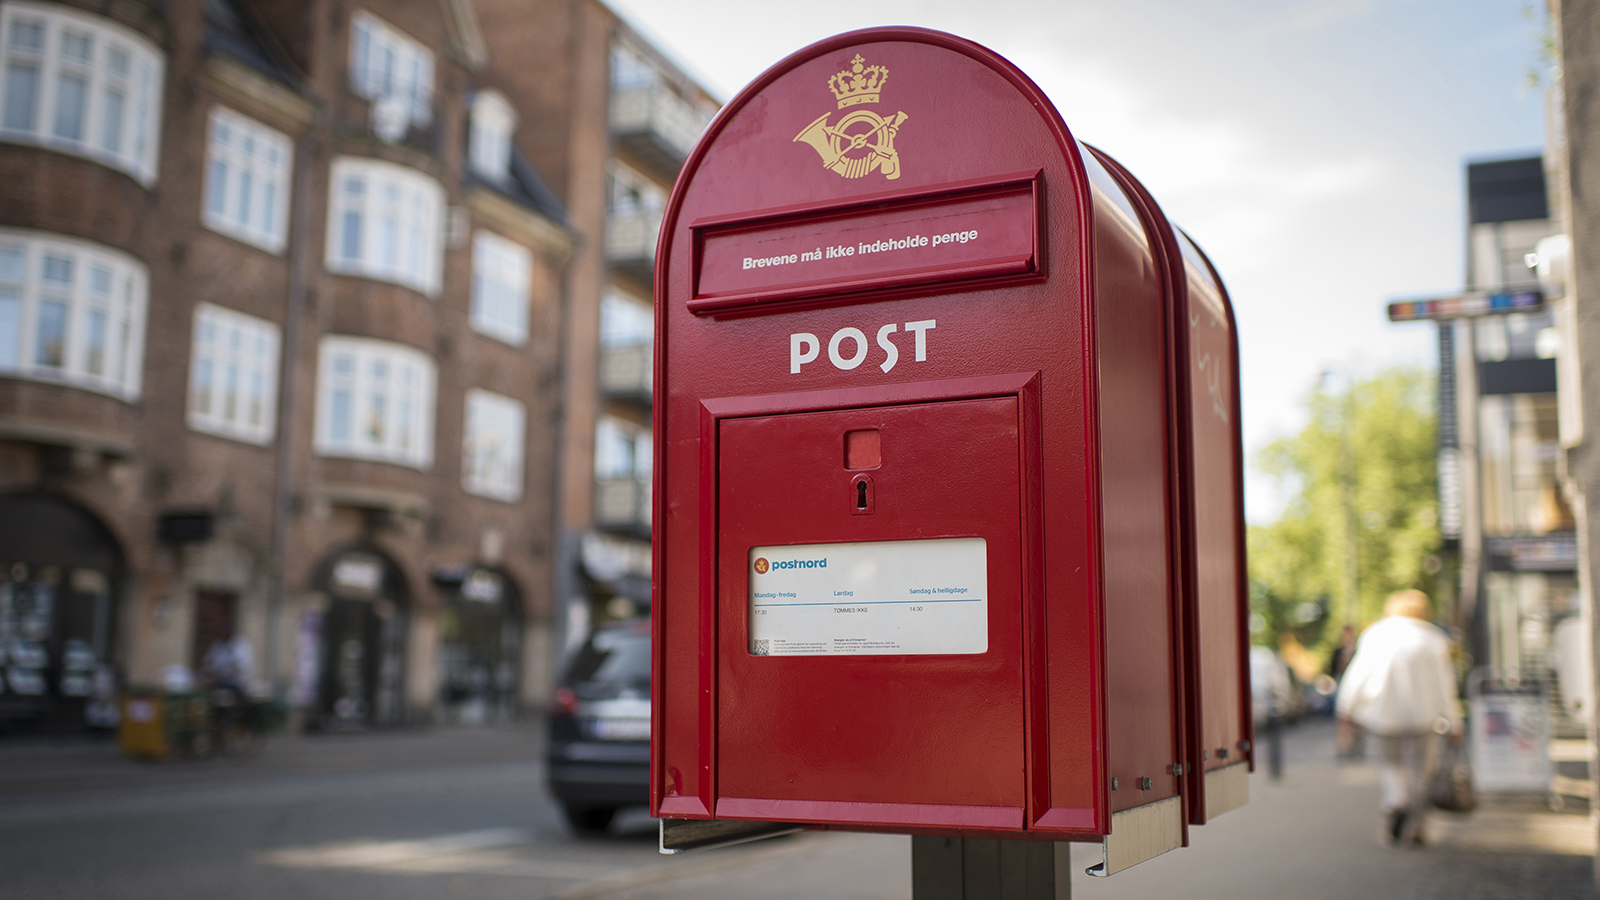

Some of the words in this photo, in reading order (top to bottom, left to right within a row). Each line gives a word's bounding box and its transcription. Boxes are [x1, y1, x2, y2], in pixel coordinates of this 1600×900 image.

[743, 252, 797, 270] Brevene
[801, 247, 822, 263] må
[826, 243, 854, 259] ikke
[858, 235, 928, 255] indeholde
[932, 230, 978, 247] penge
[790, 319, 936, 374] POST
[772, 558, 827, 571] postnord
